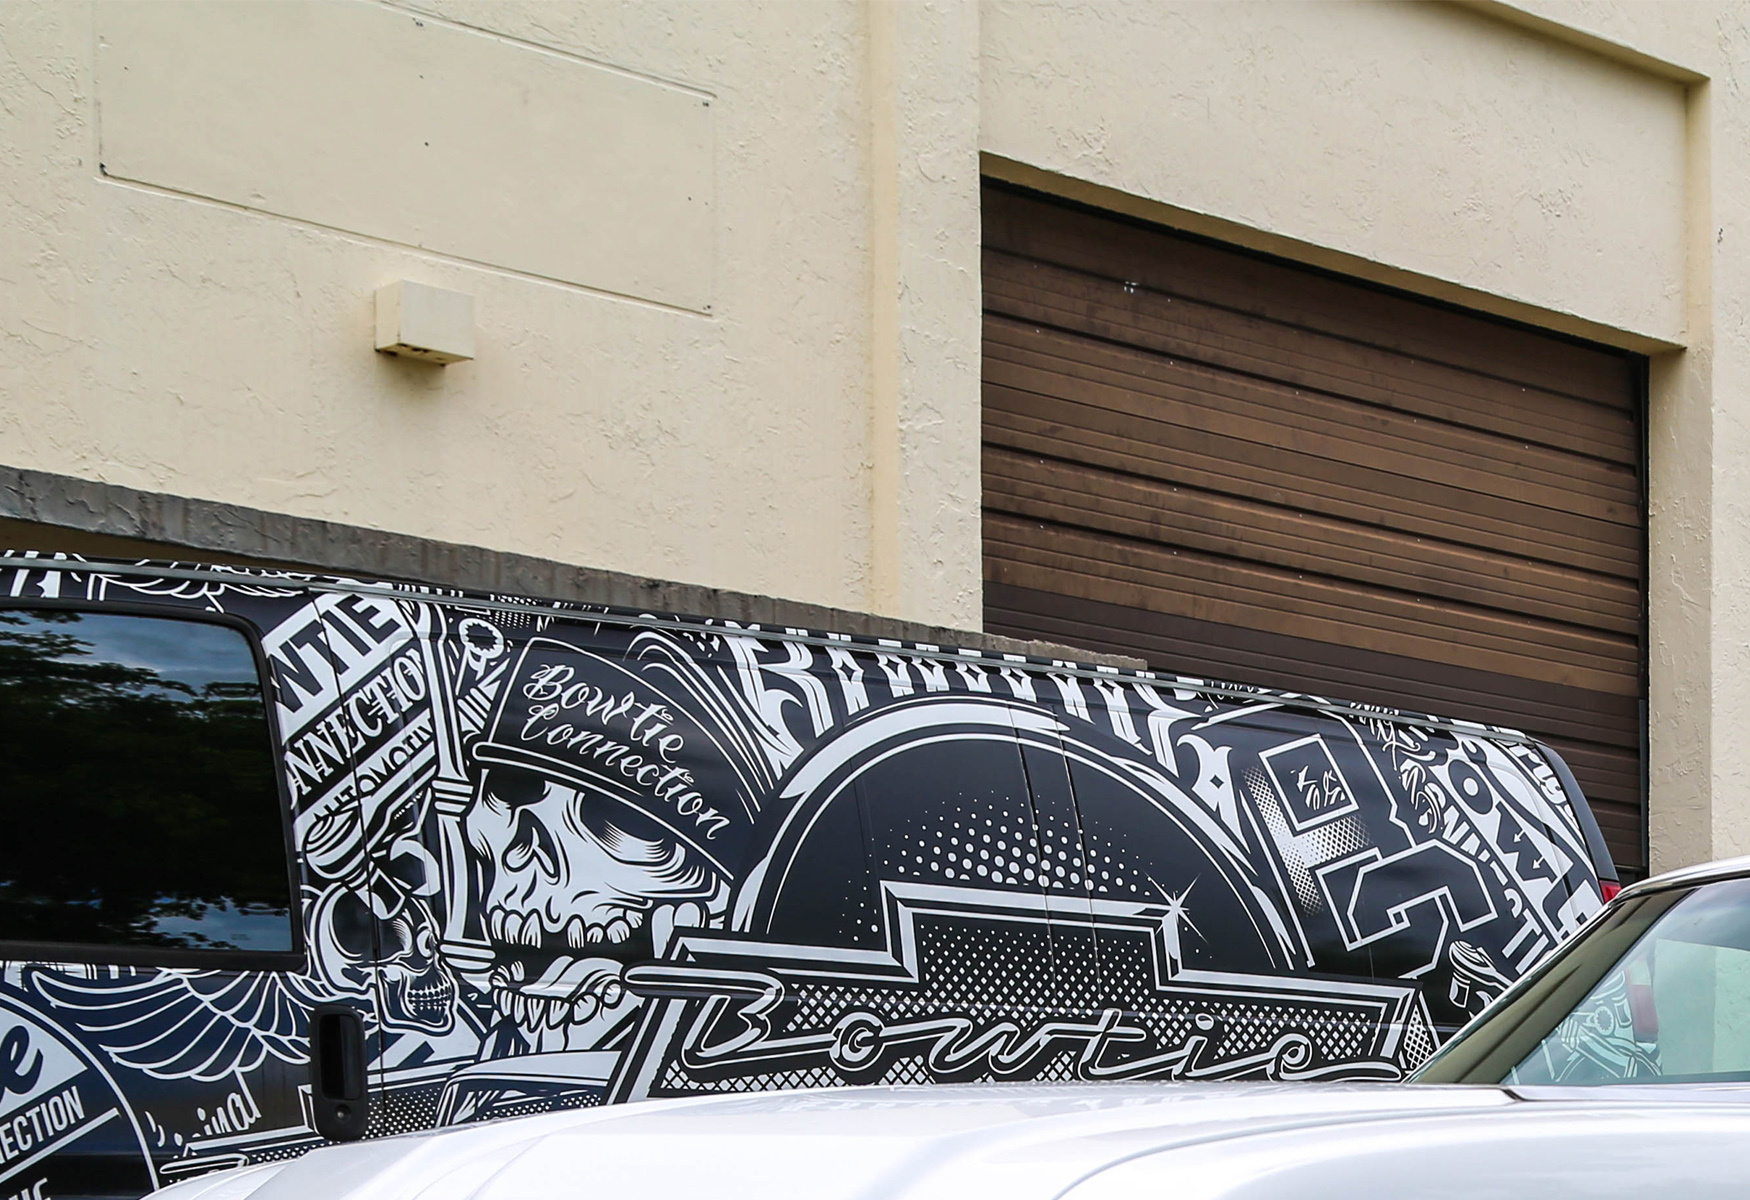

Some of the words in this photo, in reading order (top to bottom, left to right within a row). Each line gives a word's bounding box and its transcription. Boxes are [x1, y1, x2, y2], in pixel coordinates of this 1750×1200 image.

[523, 664, 685, 764] Bowtie
[520, 702, 731, 840] Connection
[621, 963, 1402, 1082] Bowtie
[0, 1085, 85, 1164] ECTION
